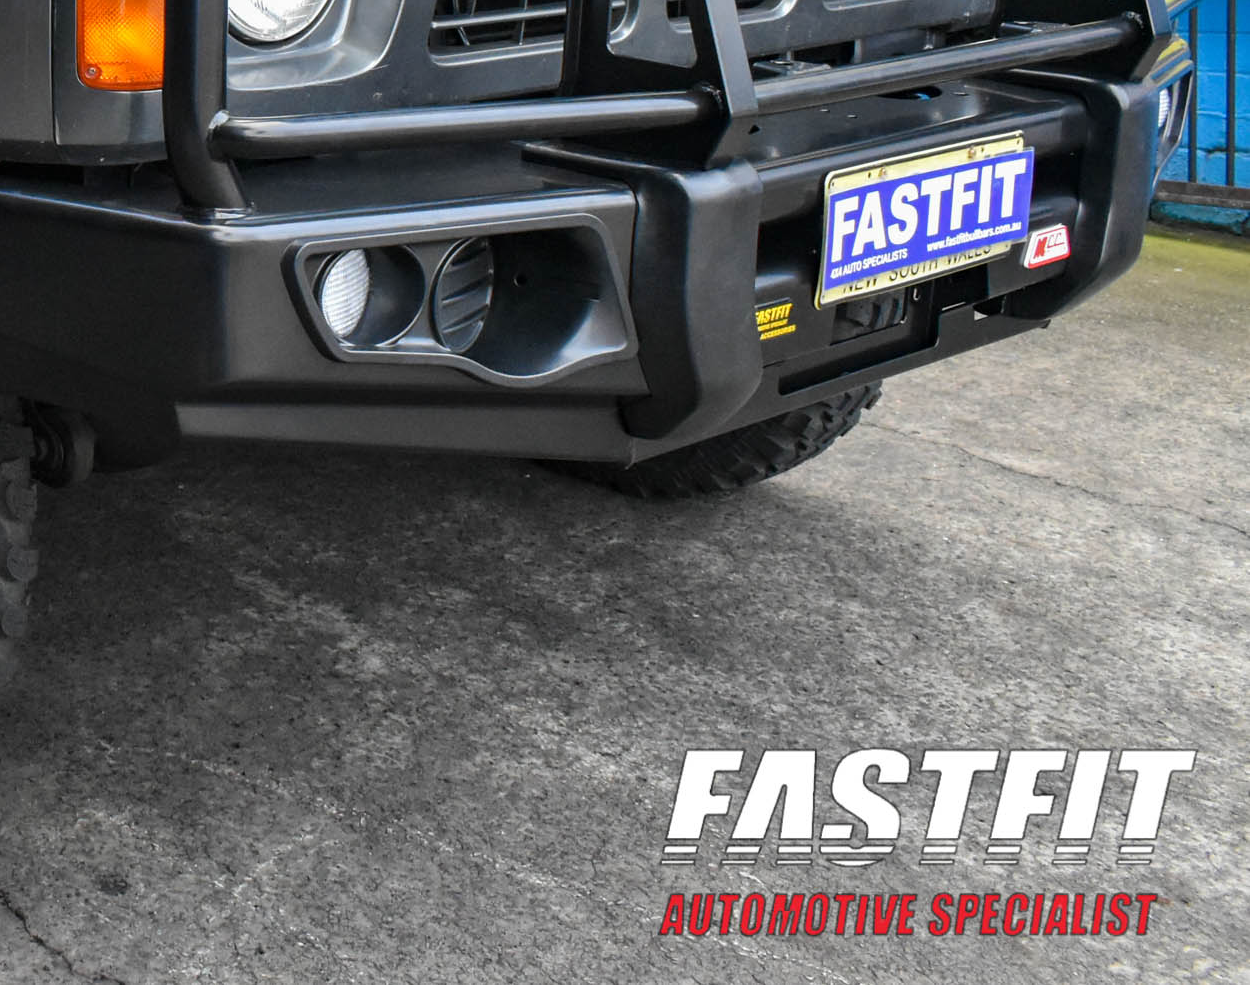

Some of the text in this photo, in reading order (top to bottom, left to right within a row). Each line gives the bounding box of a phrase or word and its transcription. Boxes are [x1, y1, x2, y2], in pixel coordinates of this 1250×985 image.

[831, 158, 1027, 264] FASTFIT
[926, 221, 1022, 252] www.fastfitbullbars.com.au
[843, 260, 863, 275] AUTO
[862, 248, 908, 270] SPECIALISTS
